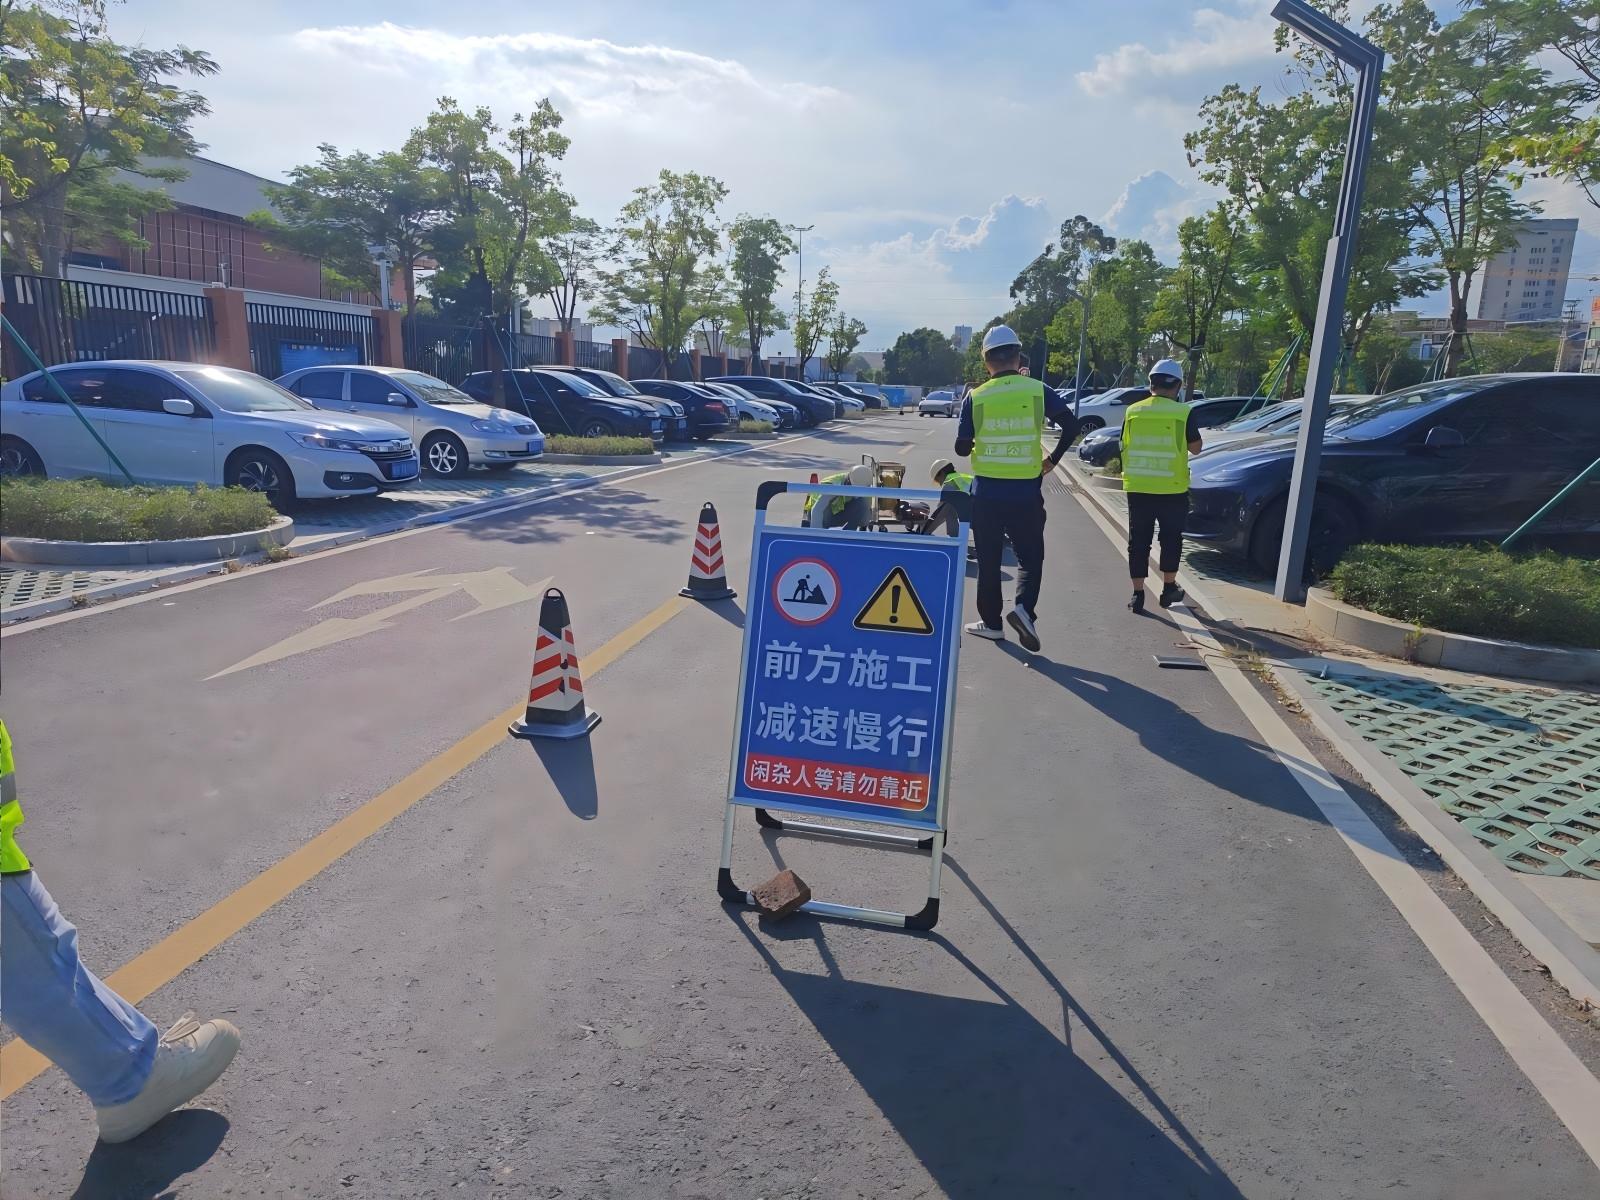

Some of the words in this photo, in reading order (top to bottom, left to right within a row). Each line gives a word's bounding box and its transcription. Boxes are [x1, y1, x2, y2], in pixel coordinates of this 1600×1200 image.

[765, 641, 932, 693] 前方施工
[757, 702, 928, 757] 减速慢行
[751, 761, 922, 802] 闲杂人等请勿靠近
